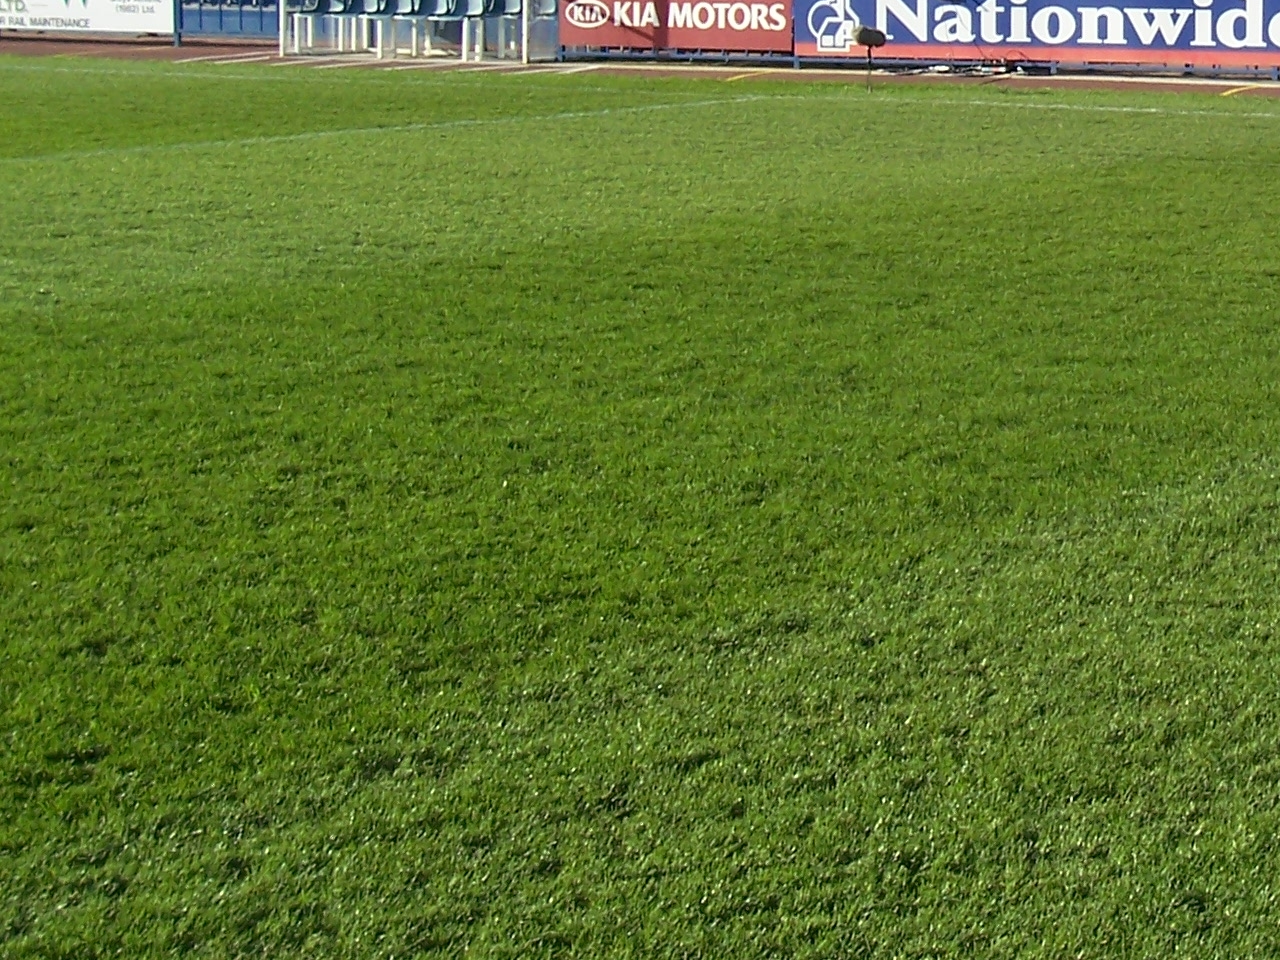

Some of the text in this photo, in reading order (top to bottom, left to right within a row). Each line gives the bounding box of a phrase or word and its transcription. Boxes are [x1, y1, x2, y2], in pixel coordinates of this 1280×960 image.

[573, 6, 603, 21] KIA
[613, 1, 787, 31] KIA MOTORS
[30, 18, 90, 28] MAINTENANCE
